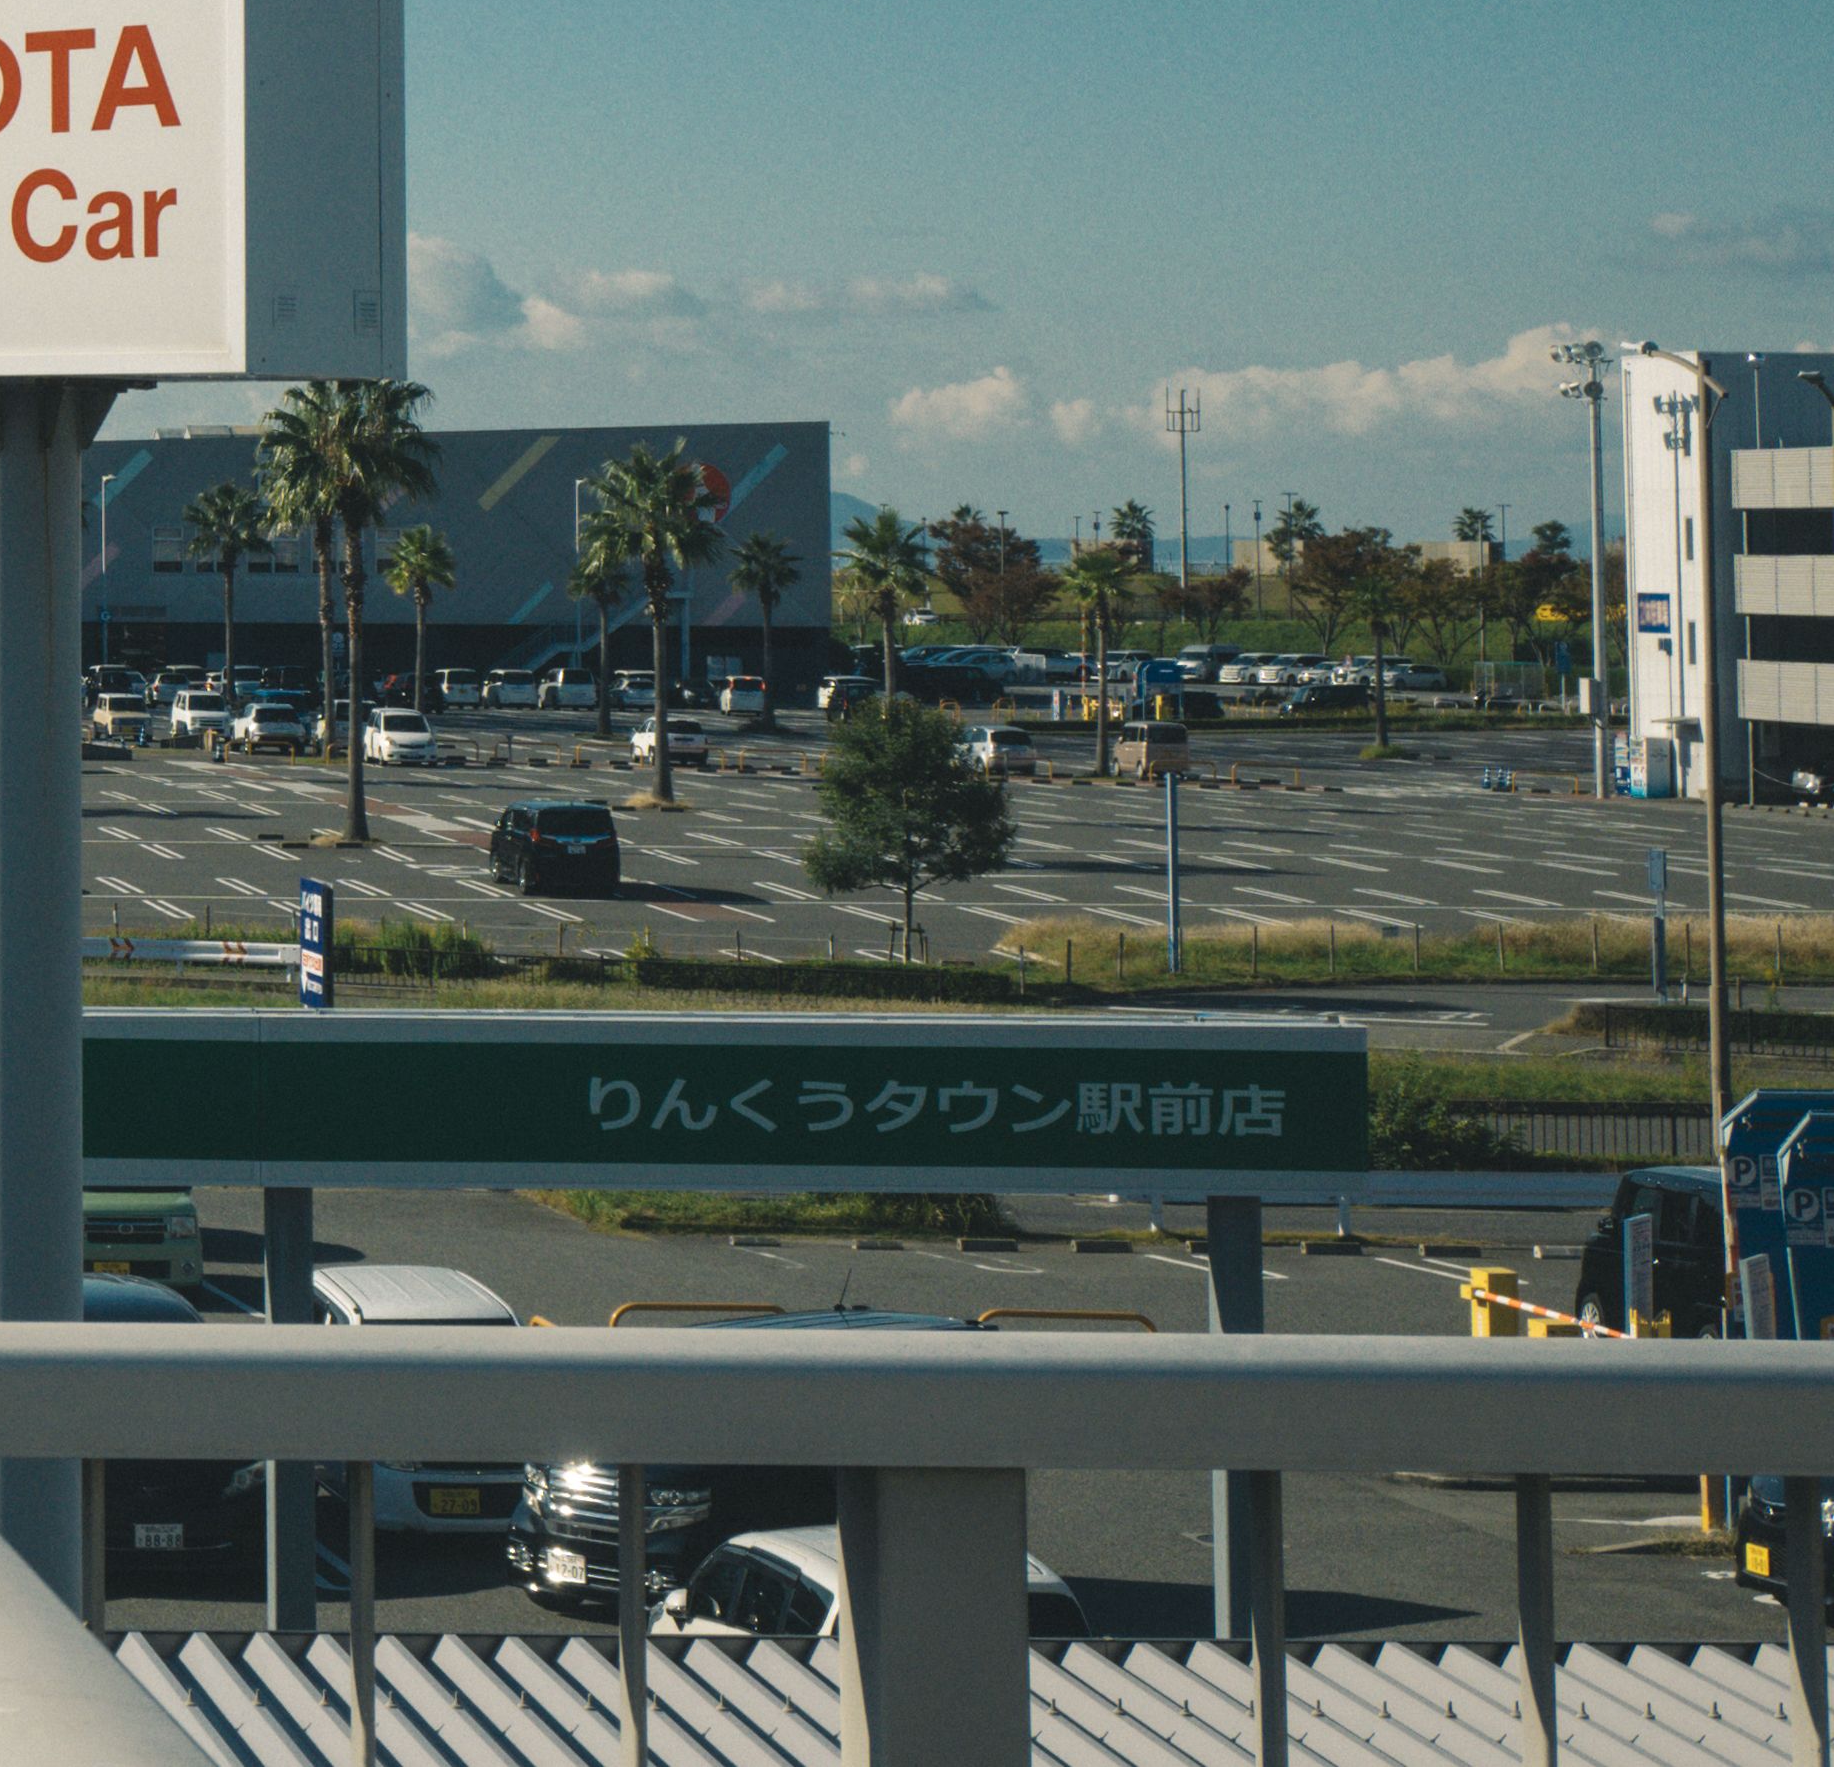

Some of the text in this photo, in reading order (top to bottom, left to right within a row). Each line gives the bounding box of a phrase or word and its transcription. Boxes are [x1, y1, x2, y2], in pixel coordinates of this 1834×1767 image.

[9, 168, 177, 263] Car
[589, 1076, 1286, 1136] りんくうタウン駅前店
[1735, 1158, 1751, 1182] P
[1794, 1192, 1813, 1218] P
[441, 1498, 479, 1513] 27-09
